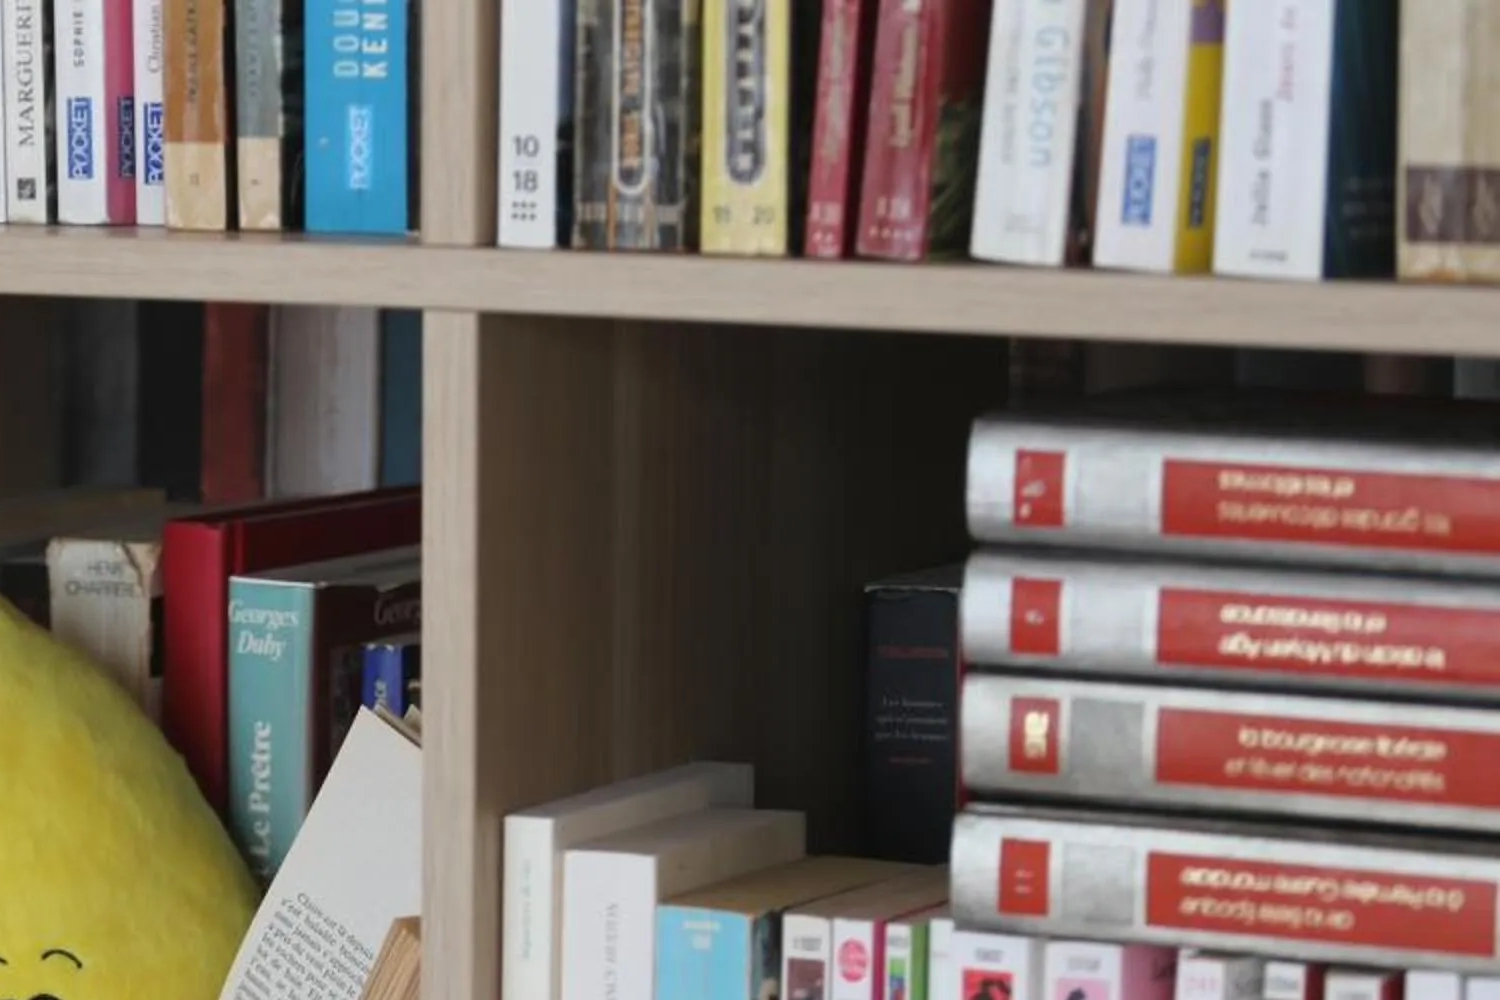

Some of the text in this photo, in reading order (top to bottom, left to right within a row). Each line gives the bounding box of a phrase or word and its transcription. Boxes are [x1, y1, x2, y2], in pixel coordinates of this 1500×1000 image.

[73, 12, 84, 68] SOPHIE
[72, 99, 90, 178] POCKET
[513, 135, 539, 158] 10
[513, 171, 538, 193] 18
[230, 600, 299, 630] Georges
[236, 632, 287, 662] Duby
[249, 719, 273, 813] Prêtre
